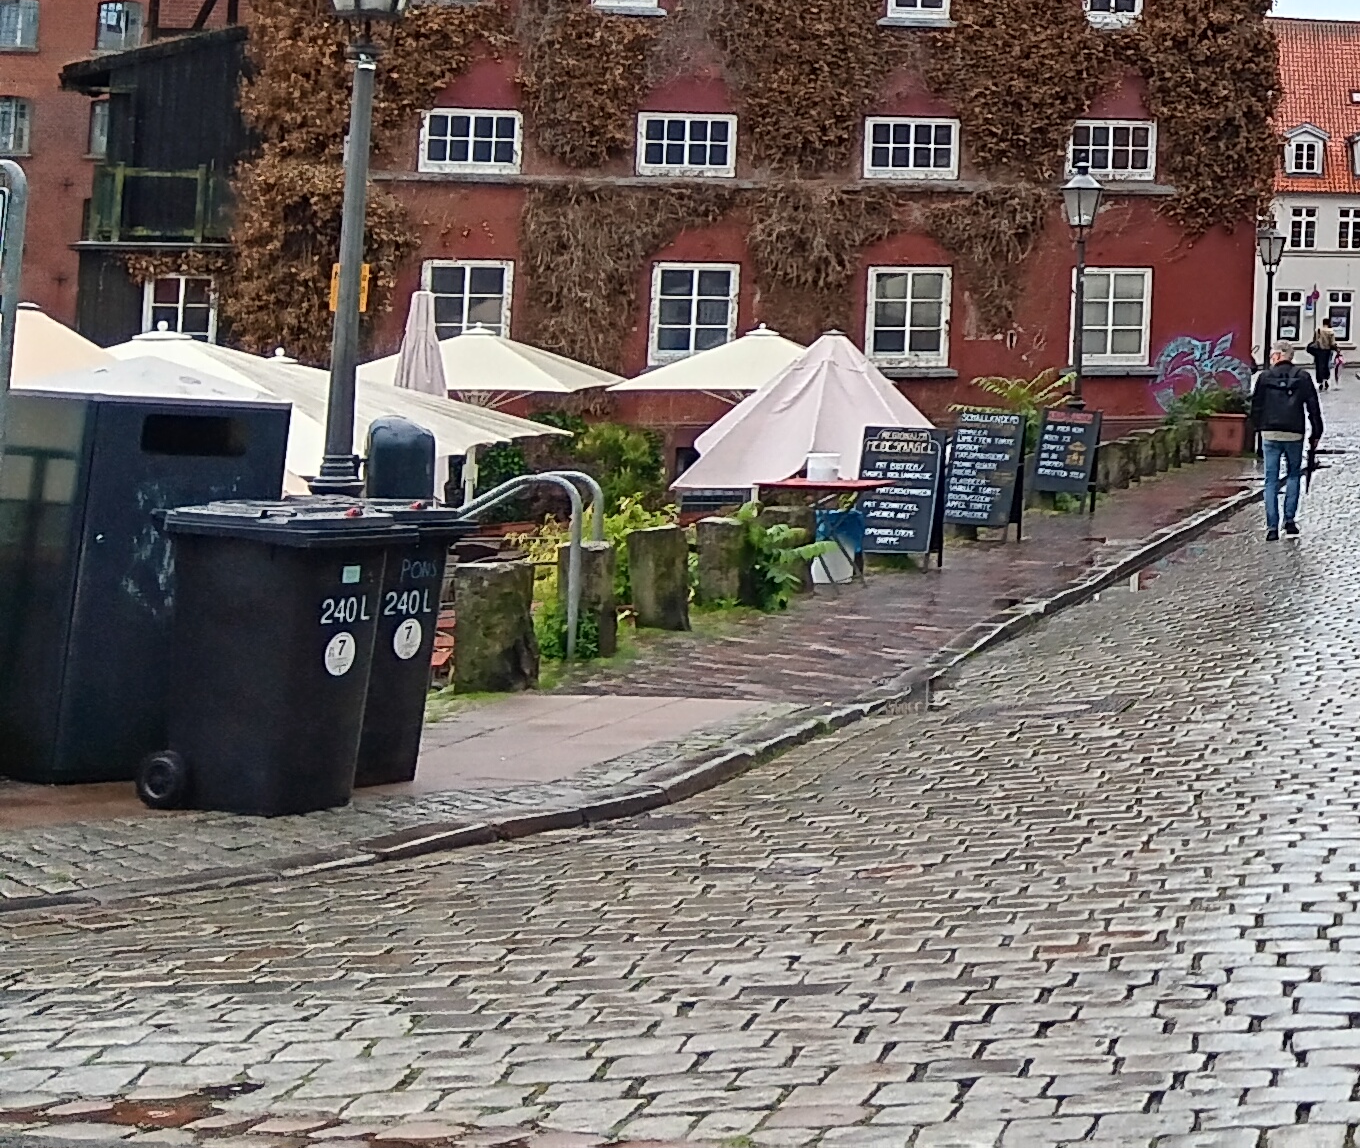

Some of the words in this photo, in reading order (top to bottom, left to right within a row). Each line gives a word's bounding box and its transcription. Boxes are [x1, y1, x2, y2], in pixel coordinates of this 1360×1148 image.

[320, 597, 358, 625] 240
[360, 594, 371, 621] L
[383, 590, 421, 616] 240
[422, 588, 432, 613] L
[404, 625, 413, 642] 7
[338, 639, 347, 656] 7
